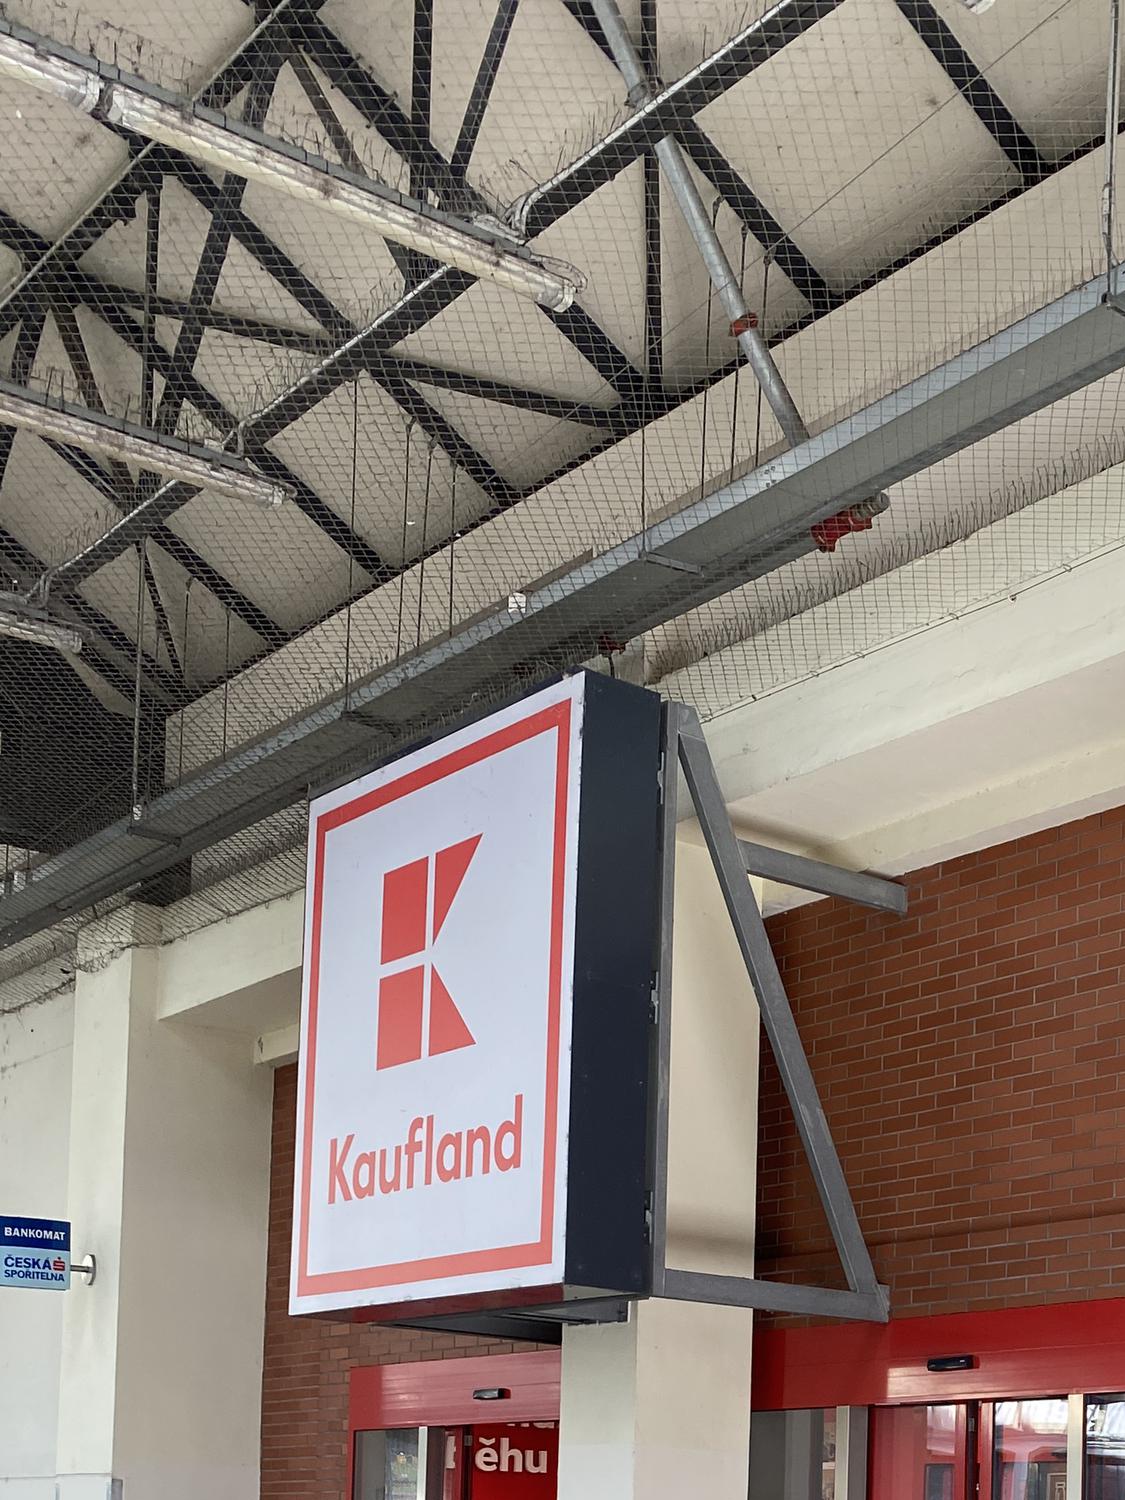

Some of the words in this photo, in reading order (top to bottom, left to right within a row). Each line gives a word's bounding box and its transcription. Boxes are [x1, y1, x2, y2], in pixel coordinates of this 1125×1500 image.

[328, 1094, 524, 1205] Kaufland
[4, 1227, 66, 1241] BANKOMAT
[4, 1253, 52, 1271] ČESKÁ
[4, 1269, 65, 1281] SPOŘITELNA
